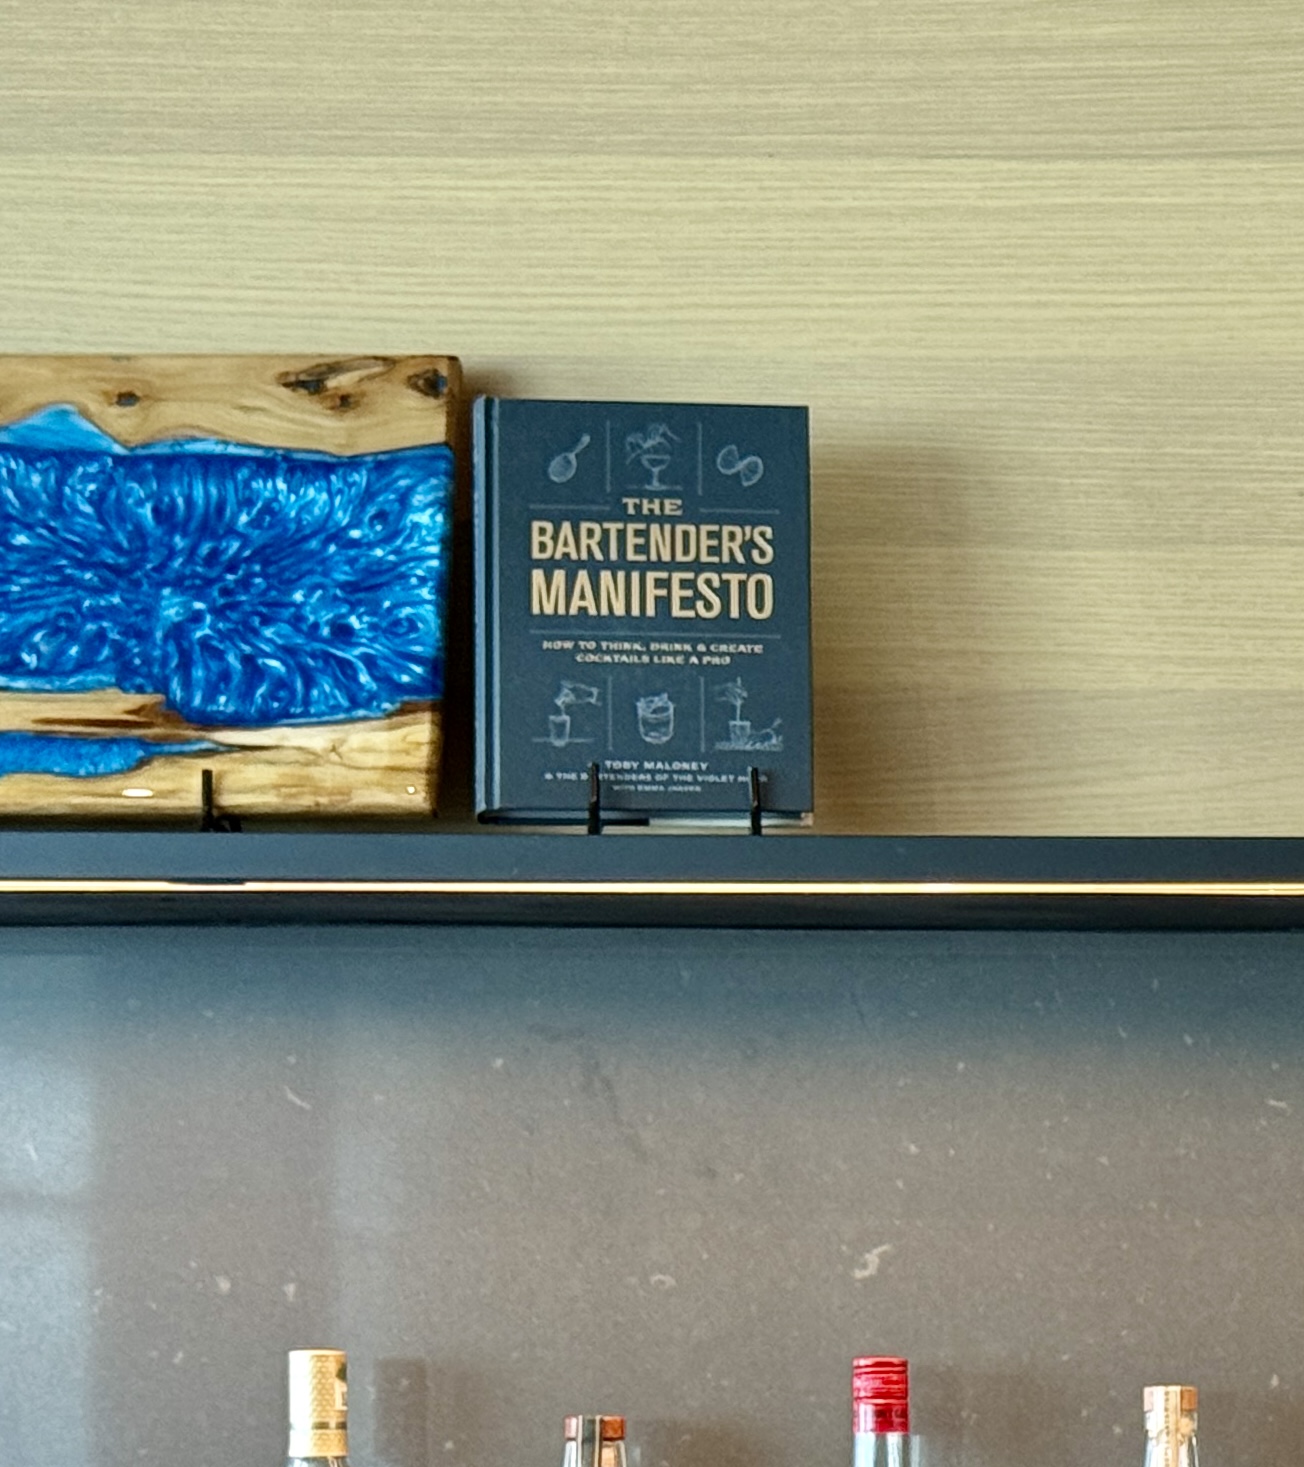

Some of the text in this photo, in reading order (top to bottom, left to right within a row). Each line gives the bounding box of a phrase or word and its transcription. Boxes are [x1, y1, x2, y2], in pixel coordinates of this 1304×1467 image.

[622, 498, 683, 516] THE
[530, 520, 774, 565] BARTENDER'S
[530, 569, 773, 620] MANIFESTO
[542, 640, 575, 650] HOW
[578, 641, 596, 650] TO
[650, 642, 692, 652] DRINK
[709, 644, 764, 654] CREATE
[575, 653, 731, 666] COCKTAILS LIKE A PRO
[605, 760, 709, 771] TOBY MALONEY
